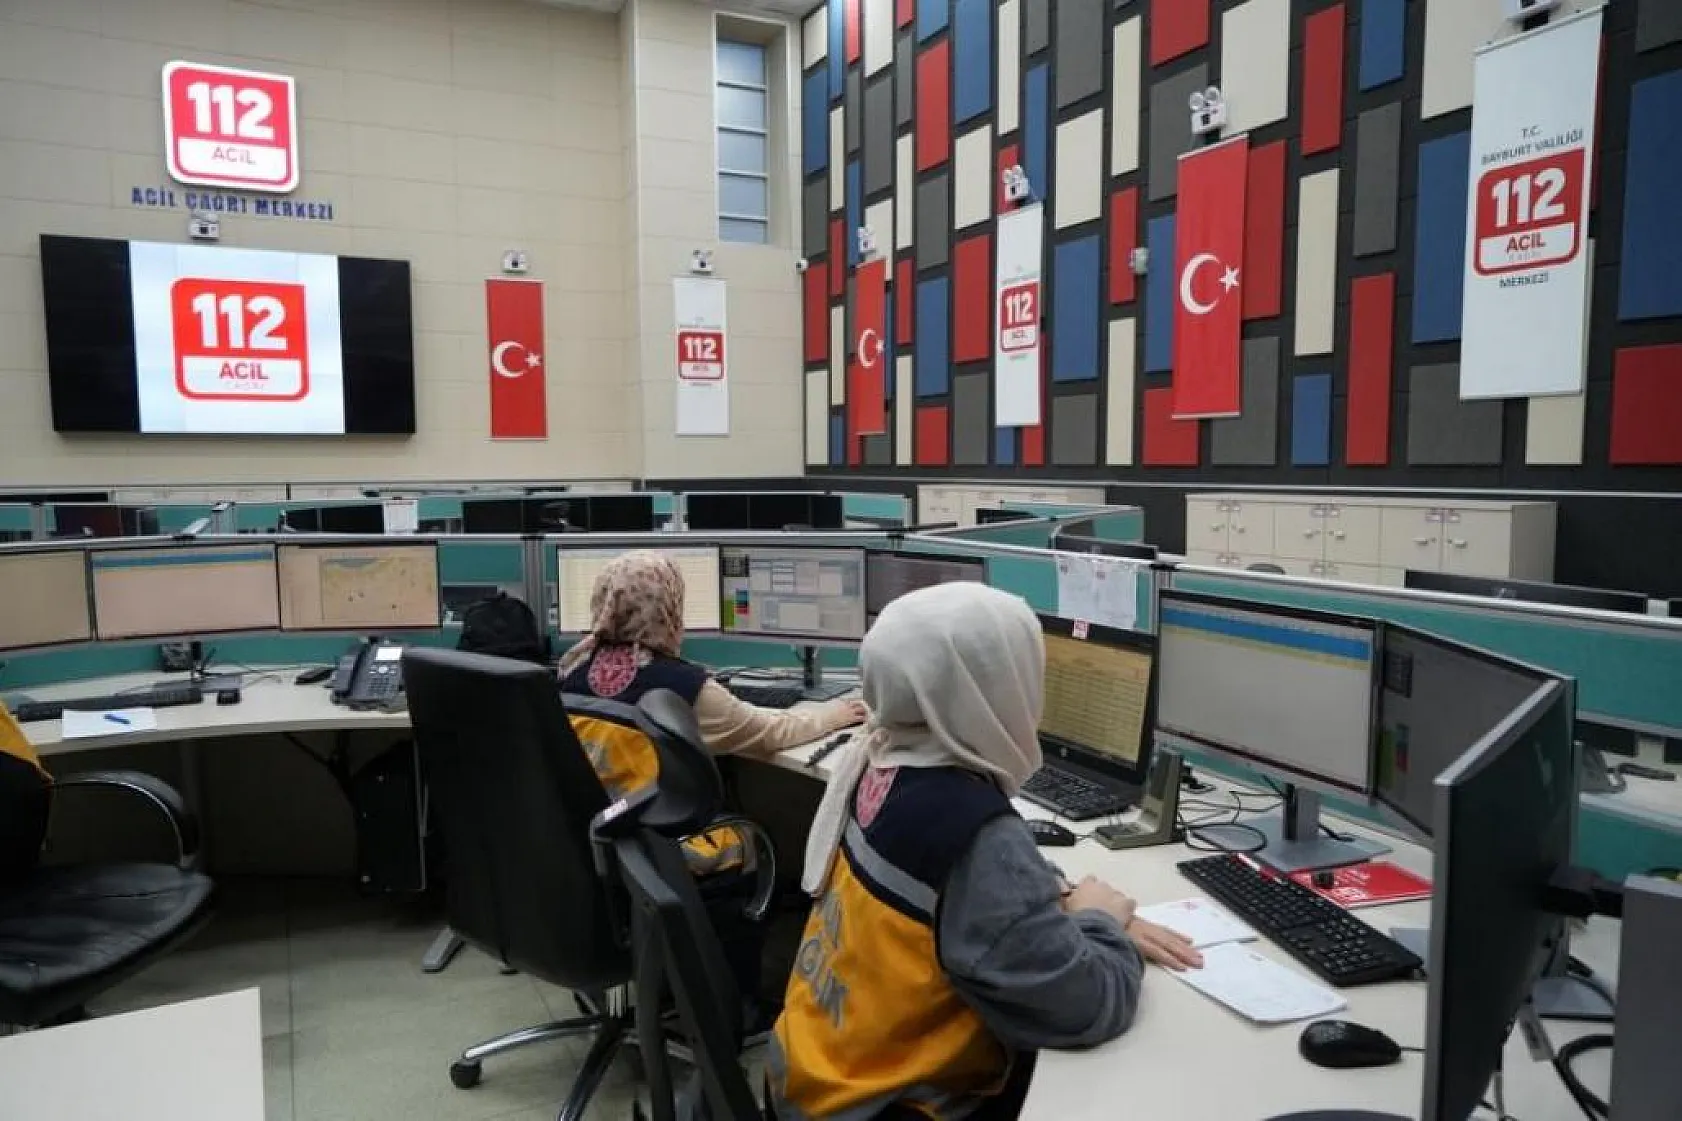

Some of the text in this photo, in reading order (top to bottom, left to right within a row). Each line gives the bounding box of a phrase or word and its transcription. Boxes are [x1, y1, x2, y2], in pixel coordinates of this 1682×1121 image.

[188, 82, 275, 140] 112
[1492, 167, 1566, 228] 112
[192, 293, 288, 350] 112
[1004, 290, 1035, 325] 112
[684, 336, 718, 359] 112
